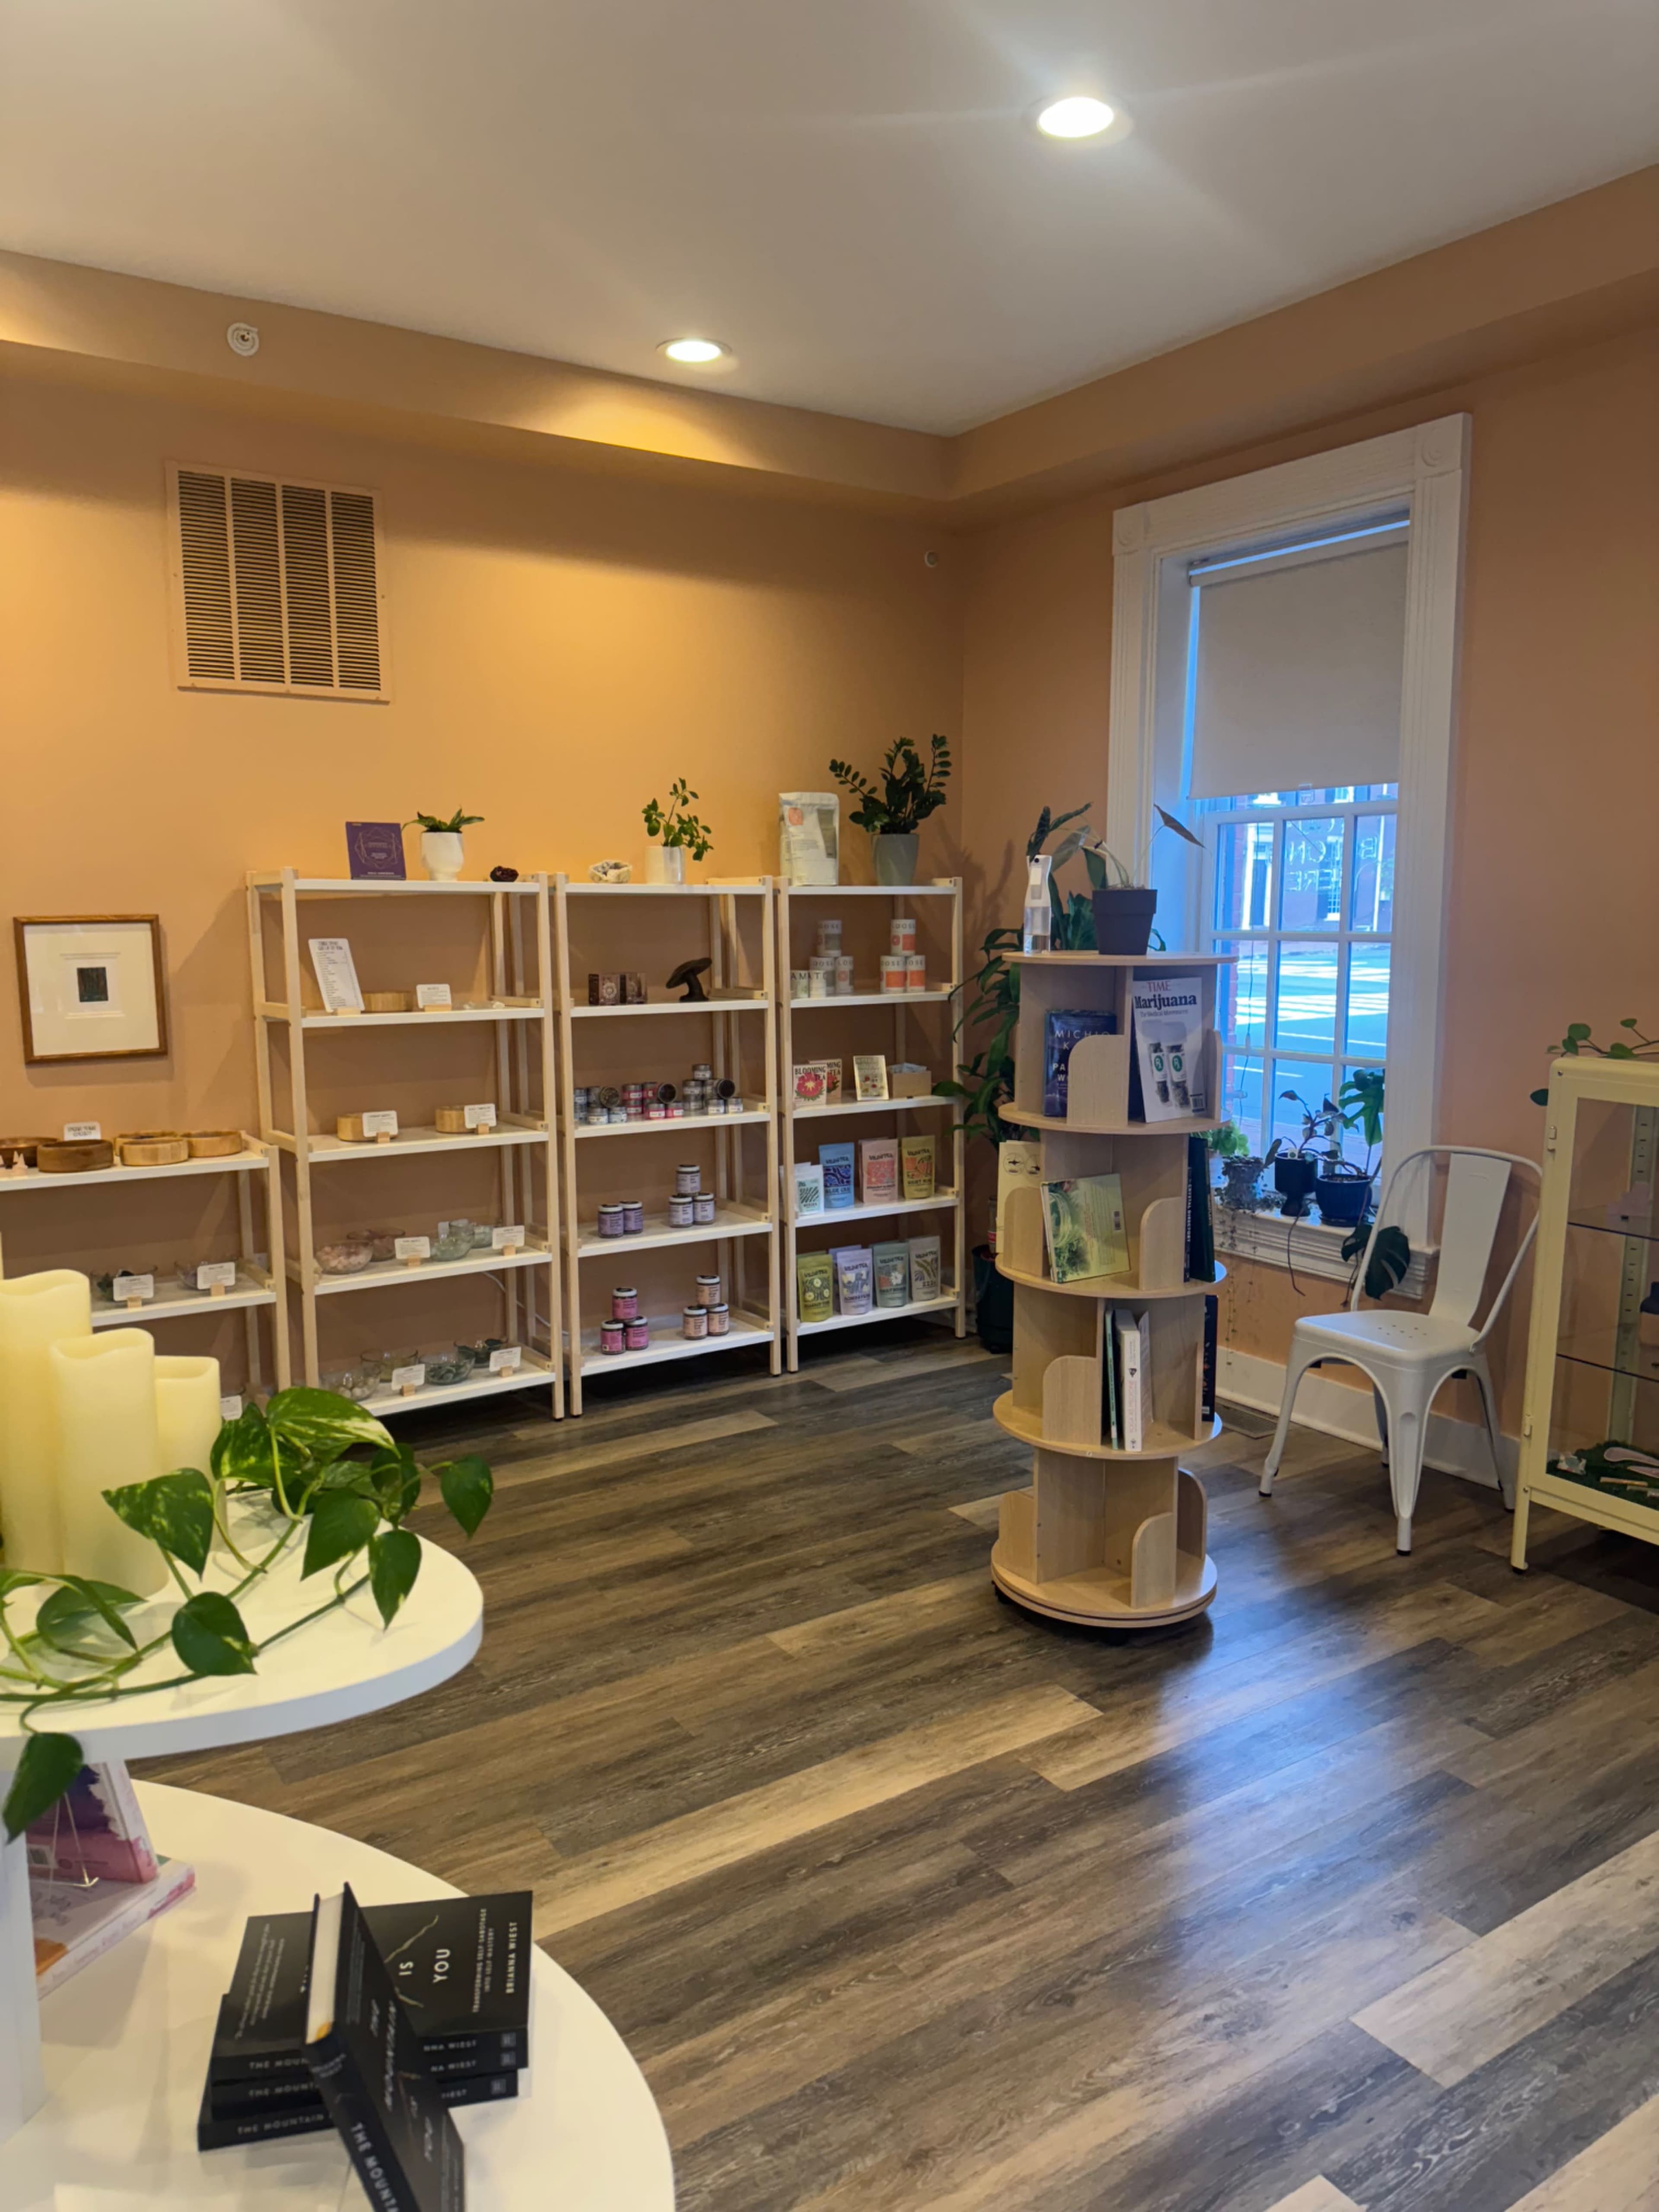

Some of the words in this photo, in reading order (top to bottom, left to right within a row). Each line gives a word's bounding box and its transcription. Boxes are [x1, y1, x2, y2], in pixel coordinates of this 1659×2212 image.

[1147, 981, 1171, 992] TIME
[1134, 994, 1197, 1011] Marijuana
[795, 1065, 826, 1075] BLOOMING
[508, 1921, 518, 1950] WIEST
[399, 1960, 414, 1976] IS
[433, 1948, 451, 1983] YOU
[505, 1951, 517, 1994] BRIANNA
[472, 1961, 484, 2013] TRANSFORMING
[249, 2059, 270, 2070] THE
[350, 2122, 372, 2152] THE
